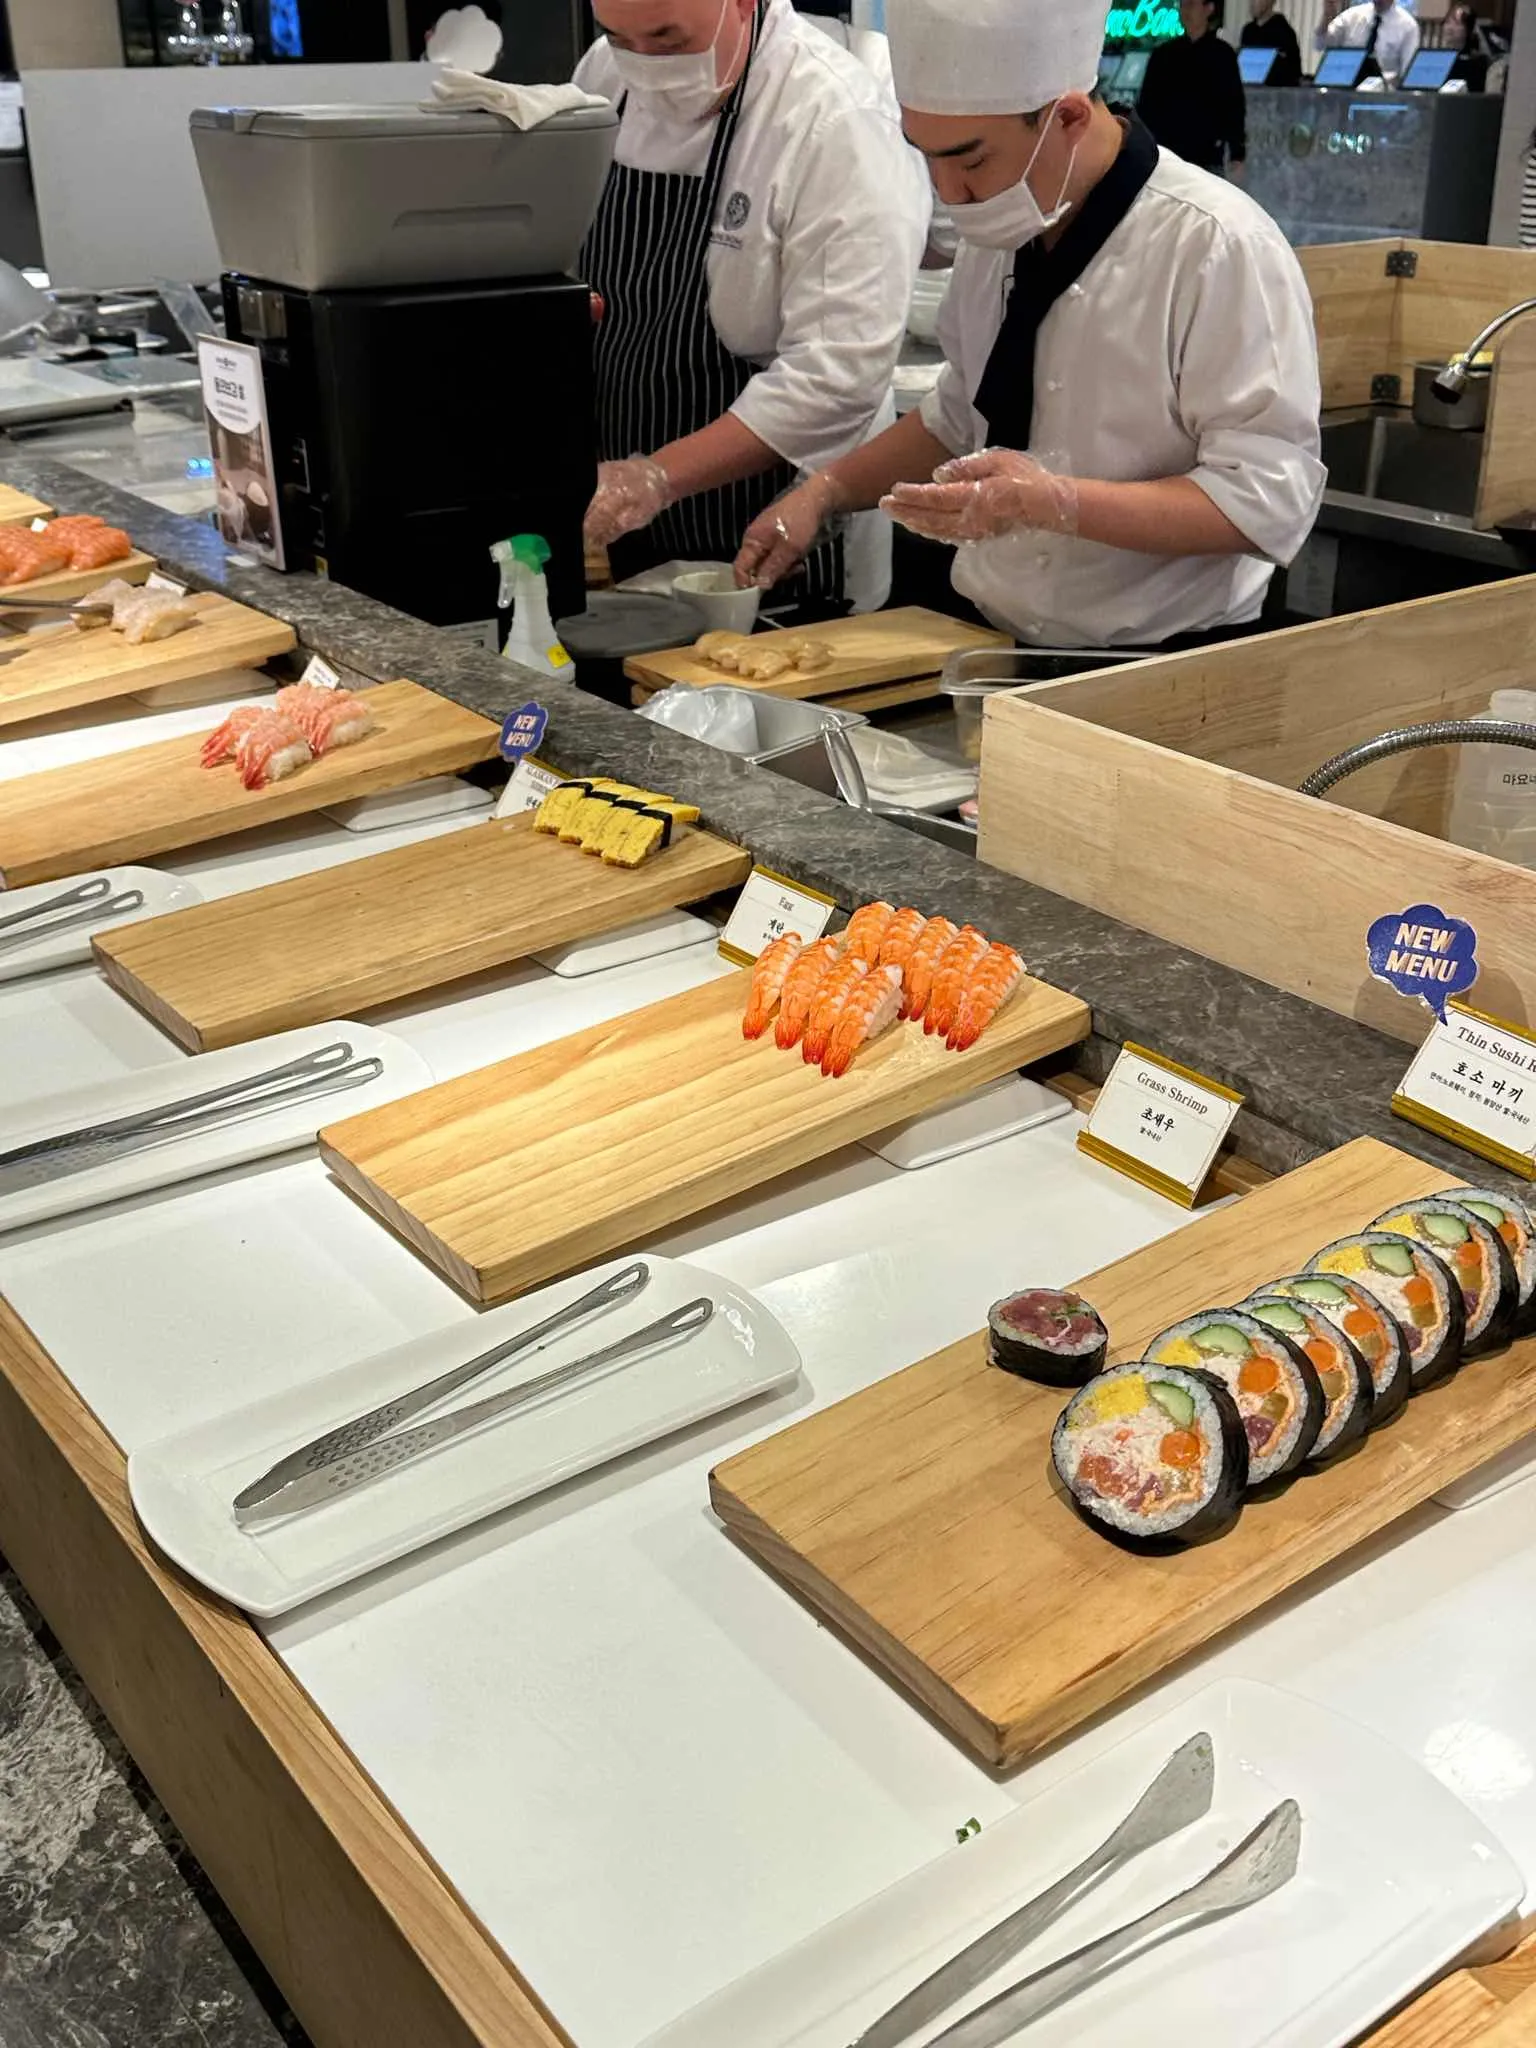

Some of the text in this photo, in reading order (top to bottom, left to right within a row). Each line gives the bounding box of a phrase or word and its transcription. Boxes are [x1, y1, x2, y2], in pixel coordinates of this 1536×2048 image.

[513, 715, 538, 730] NEW
[505, 731, 536, 748] MENU
[1393, 922, 1457, 954] NEW
[1385, 951, 1458, 983] MENU
[1456, 1026, 1488, 1049] Thin
[1488, 1041, 1528, 1067] Sushi
[1137, 1071, 1209, 1115] Grass Shrimp
[1140, 1107, 1176, 1132] 초새우
